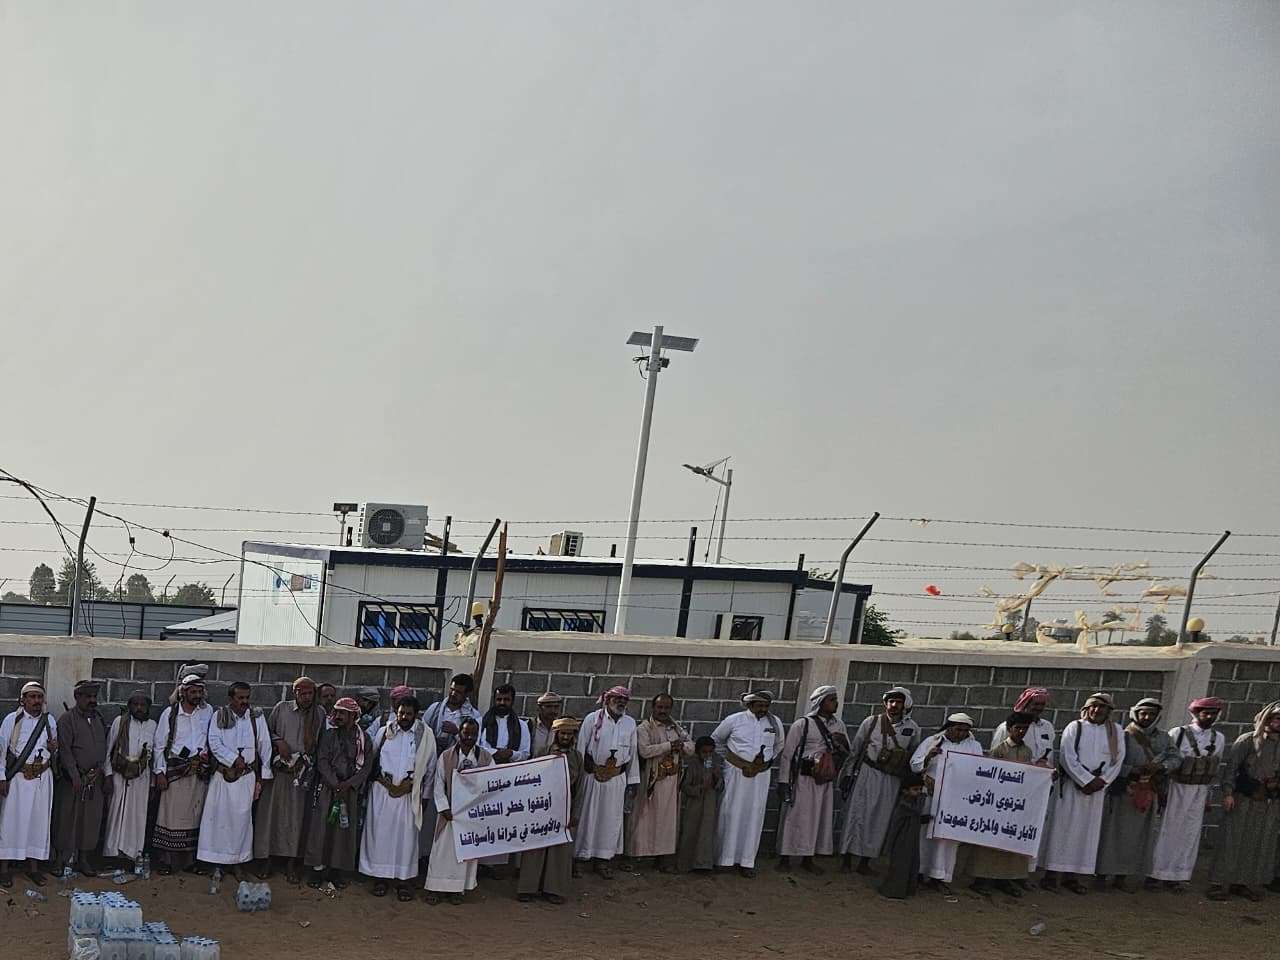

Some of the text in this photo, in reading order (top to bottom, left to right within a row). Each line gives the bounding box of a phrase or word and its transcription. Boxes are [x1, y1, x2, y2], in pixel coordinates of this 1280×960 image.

[514, 772, 542, 786] بيئتنا
[975, 766, 1025, 784] افتحوا السد
[468, 792, 552, 820] أوقفوا خطر النفايات
[996, 797, 1026, 812] لترتوي
[460, 818, 561, 847] والأوبئة في قرانا وأسواقنا
[969, 817, 999, 835] والمزارع
[1001, 822, 1017, 838] تجف
